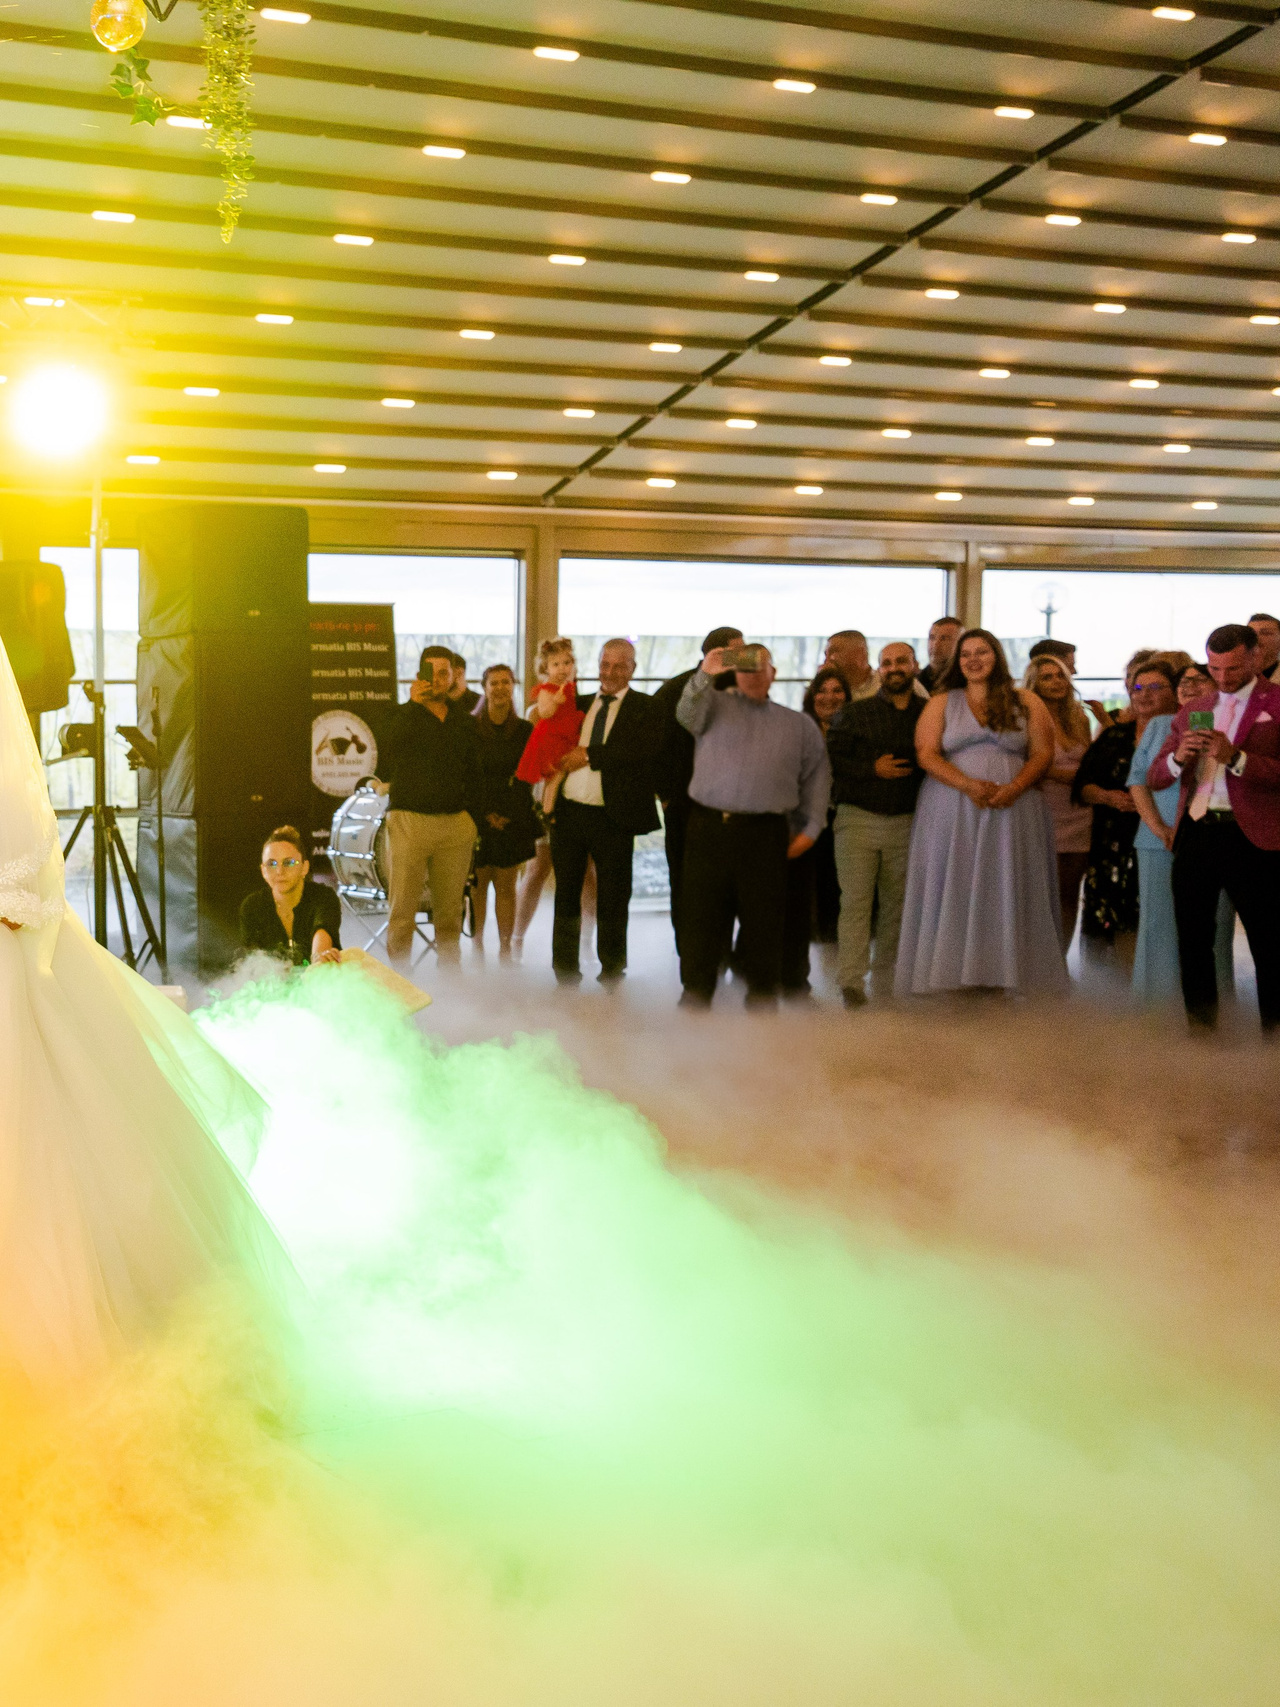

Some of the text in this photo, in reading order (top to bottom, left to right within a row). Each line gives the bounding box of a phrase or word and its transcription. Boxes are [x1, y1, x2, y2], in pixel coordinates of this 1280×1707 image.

[311, 642, 389, 652] ormatia BIS Music
[311, 667, 390, 678] ormatia BIS Music
[312, 690, 392, 701] ormatia BIS Music
[336, 756, 364, 767] Music
